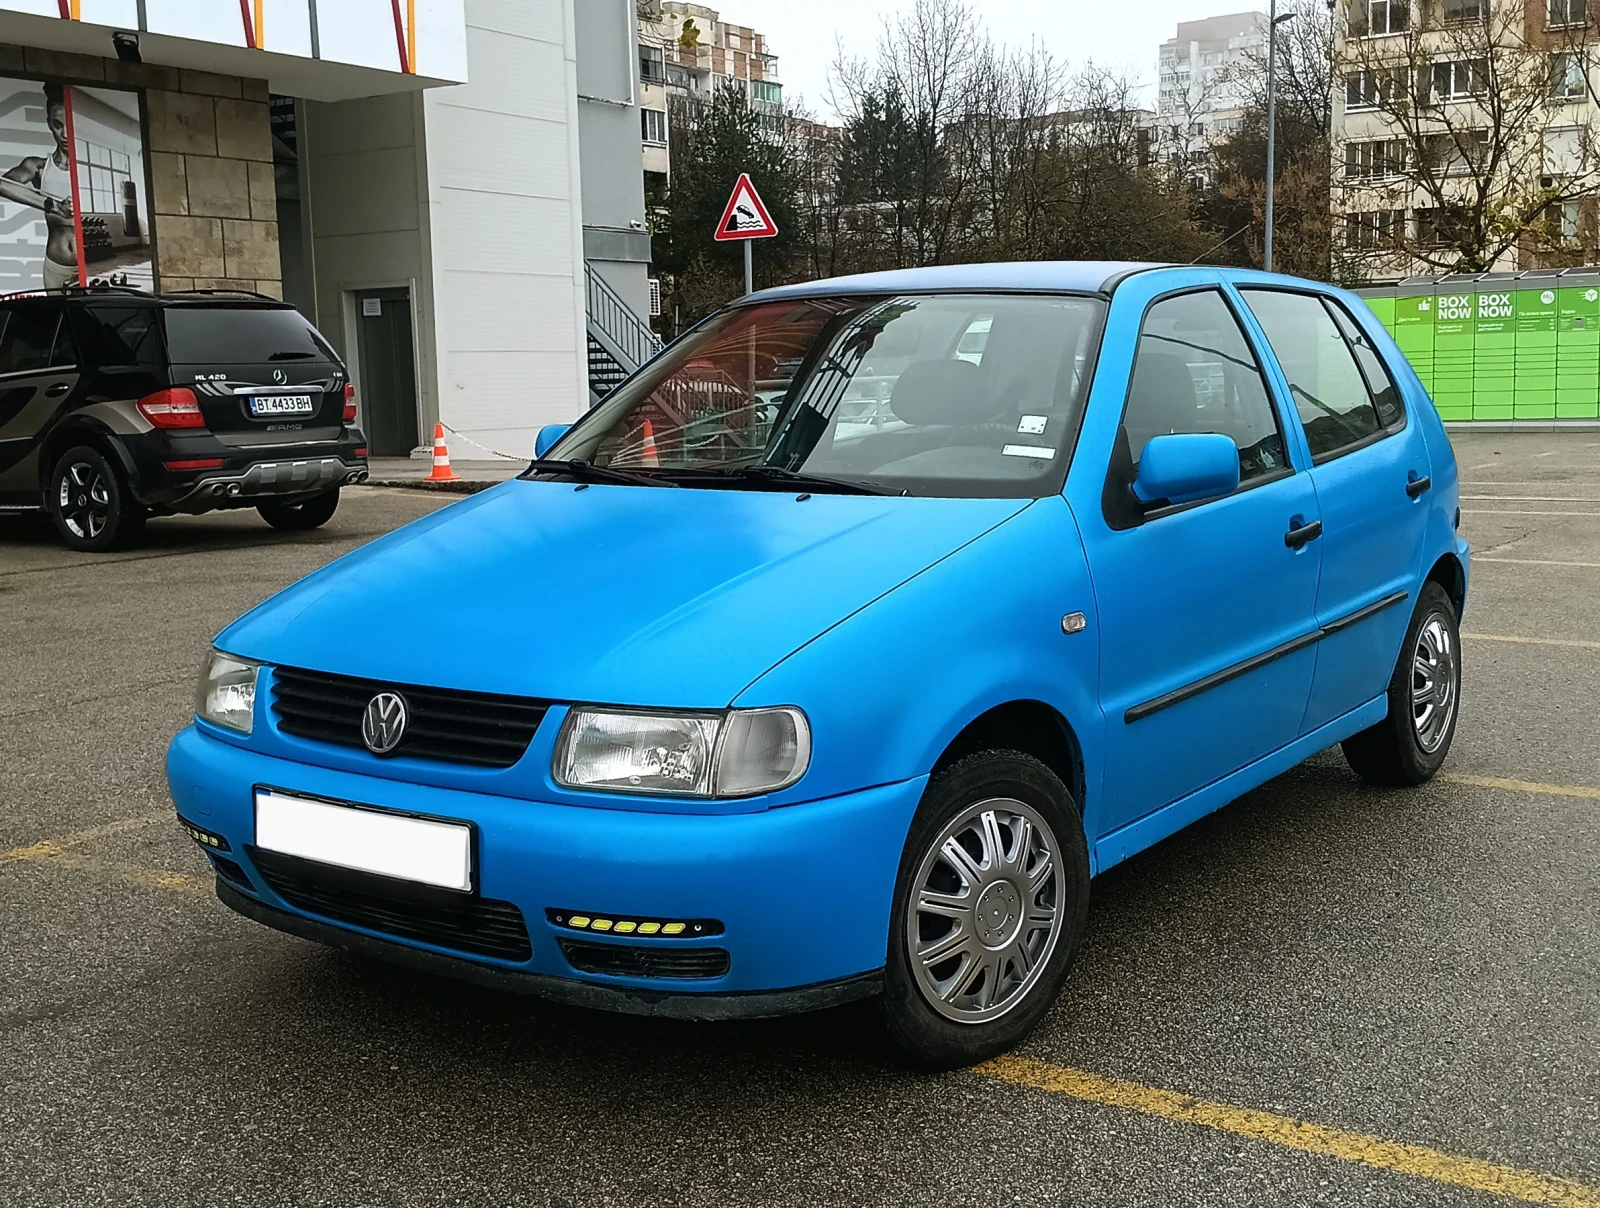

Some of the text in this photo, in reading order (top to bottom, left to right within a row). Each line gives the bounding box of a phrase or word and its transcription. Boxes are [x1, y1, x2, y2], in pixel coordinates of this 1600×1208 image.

[1438, 296, 1469, 308] BOX
[1479, 294, 1510, 306] BOX
[1438, 307, 1472, 320] NOW
[1479, 305, 1513, 318] NOW
